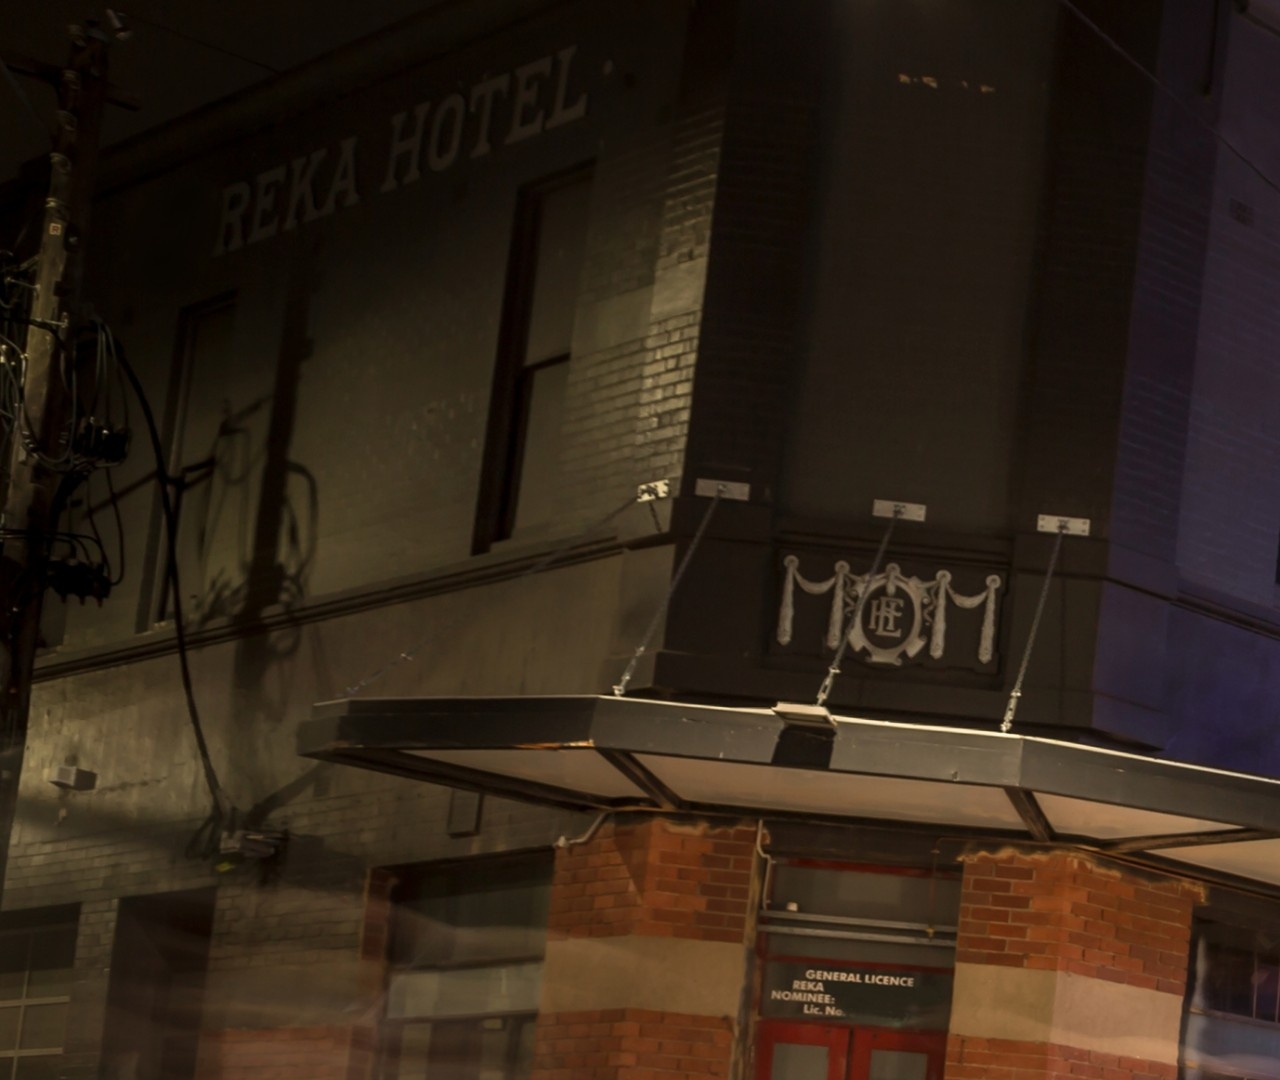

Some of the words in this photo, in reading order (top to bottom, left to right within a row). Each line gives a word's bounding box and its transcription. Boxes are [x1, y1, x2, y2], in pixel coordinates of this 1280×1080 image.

[217, 136, 360, 254] REKA
[381, 45, 588, 193] HOTEL
[805, 969, 862, 983] GENERAL
[864, 974, 914, 987] LICENCE
[792, 980, 824, 991] REKA
[771, 990, 835, 1004] NOMINEE:
[803, 1004, 823, 1015] Lic.
[825, 1006, 846, 1016] No.
